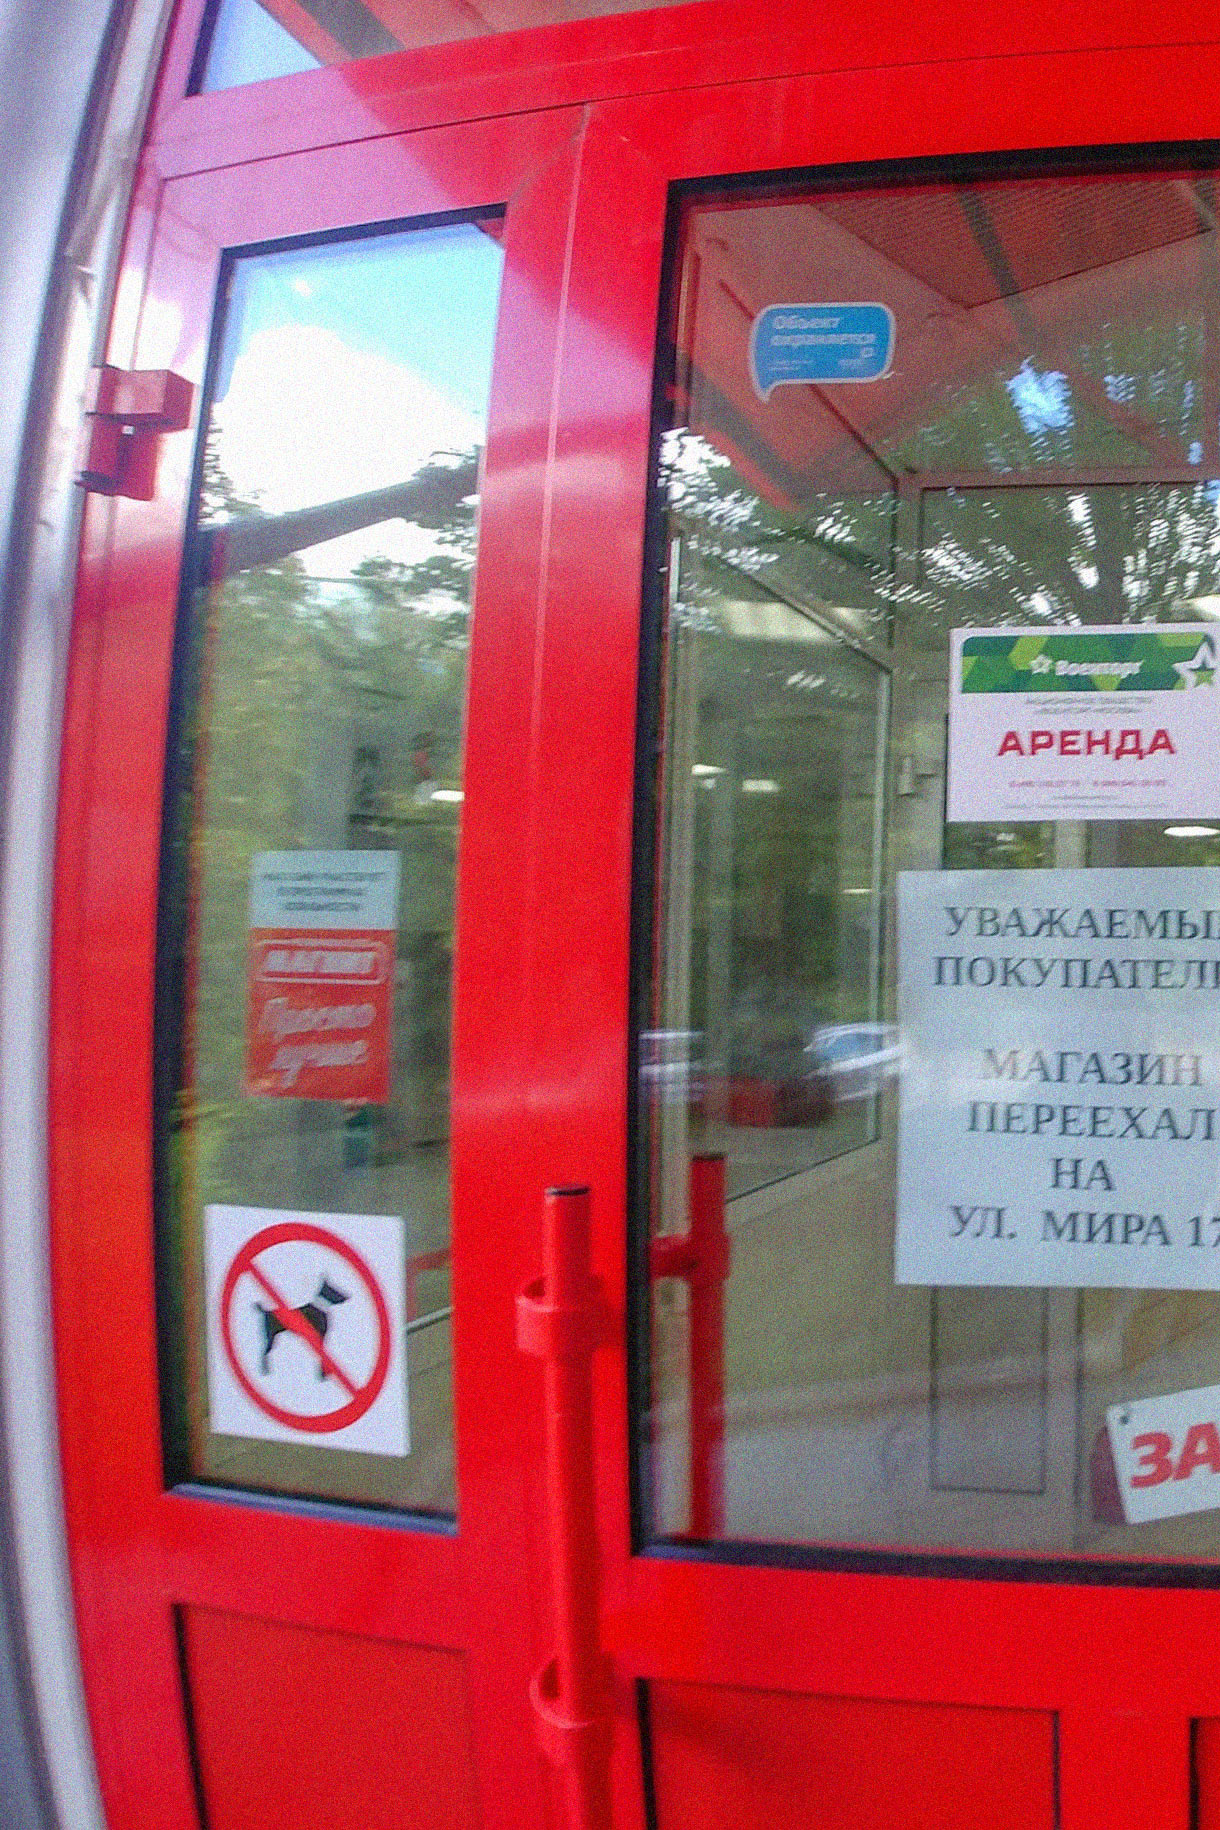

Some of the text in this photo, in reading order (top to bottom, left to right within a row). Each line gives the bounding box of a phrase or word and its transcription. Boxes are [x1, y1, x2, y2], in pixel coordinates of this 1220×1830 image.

[997, 729, 1176, 760] АРЕНДА
[980, 1049, 1203, 1087] МАГАЗИН
[967, 1101, 1218, 1141] ПЕРЕЕХАЛ
[1050, 1157, 1117, 1192] НА
[949, 1205, 1017, 1240] УЛ.
[1041, 1210, 1172, 1247] МИРА
